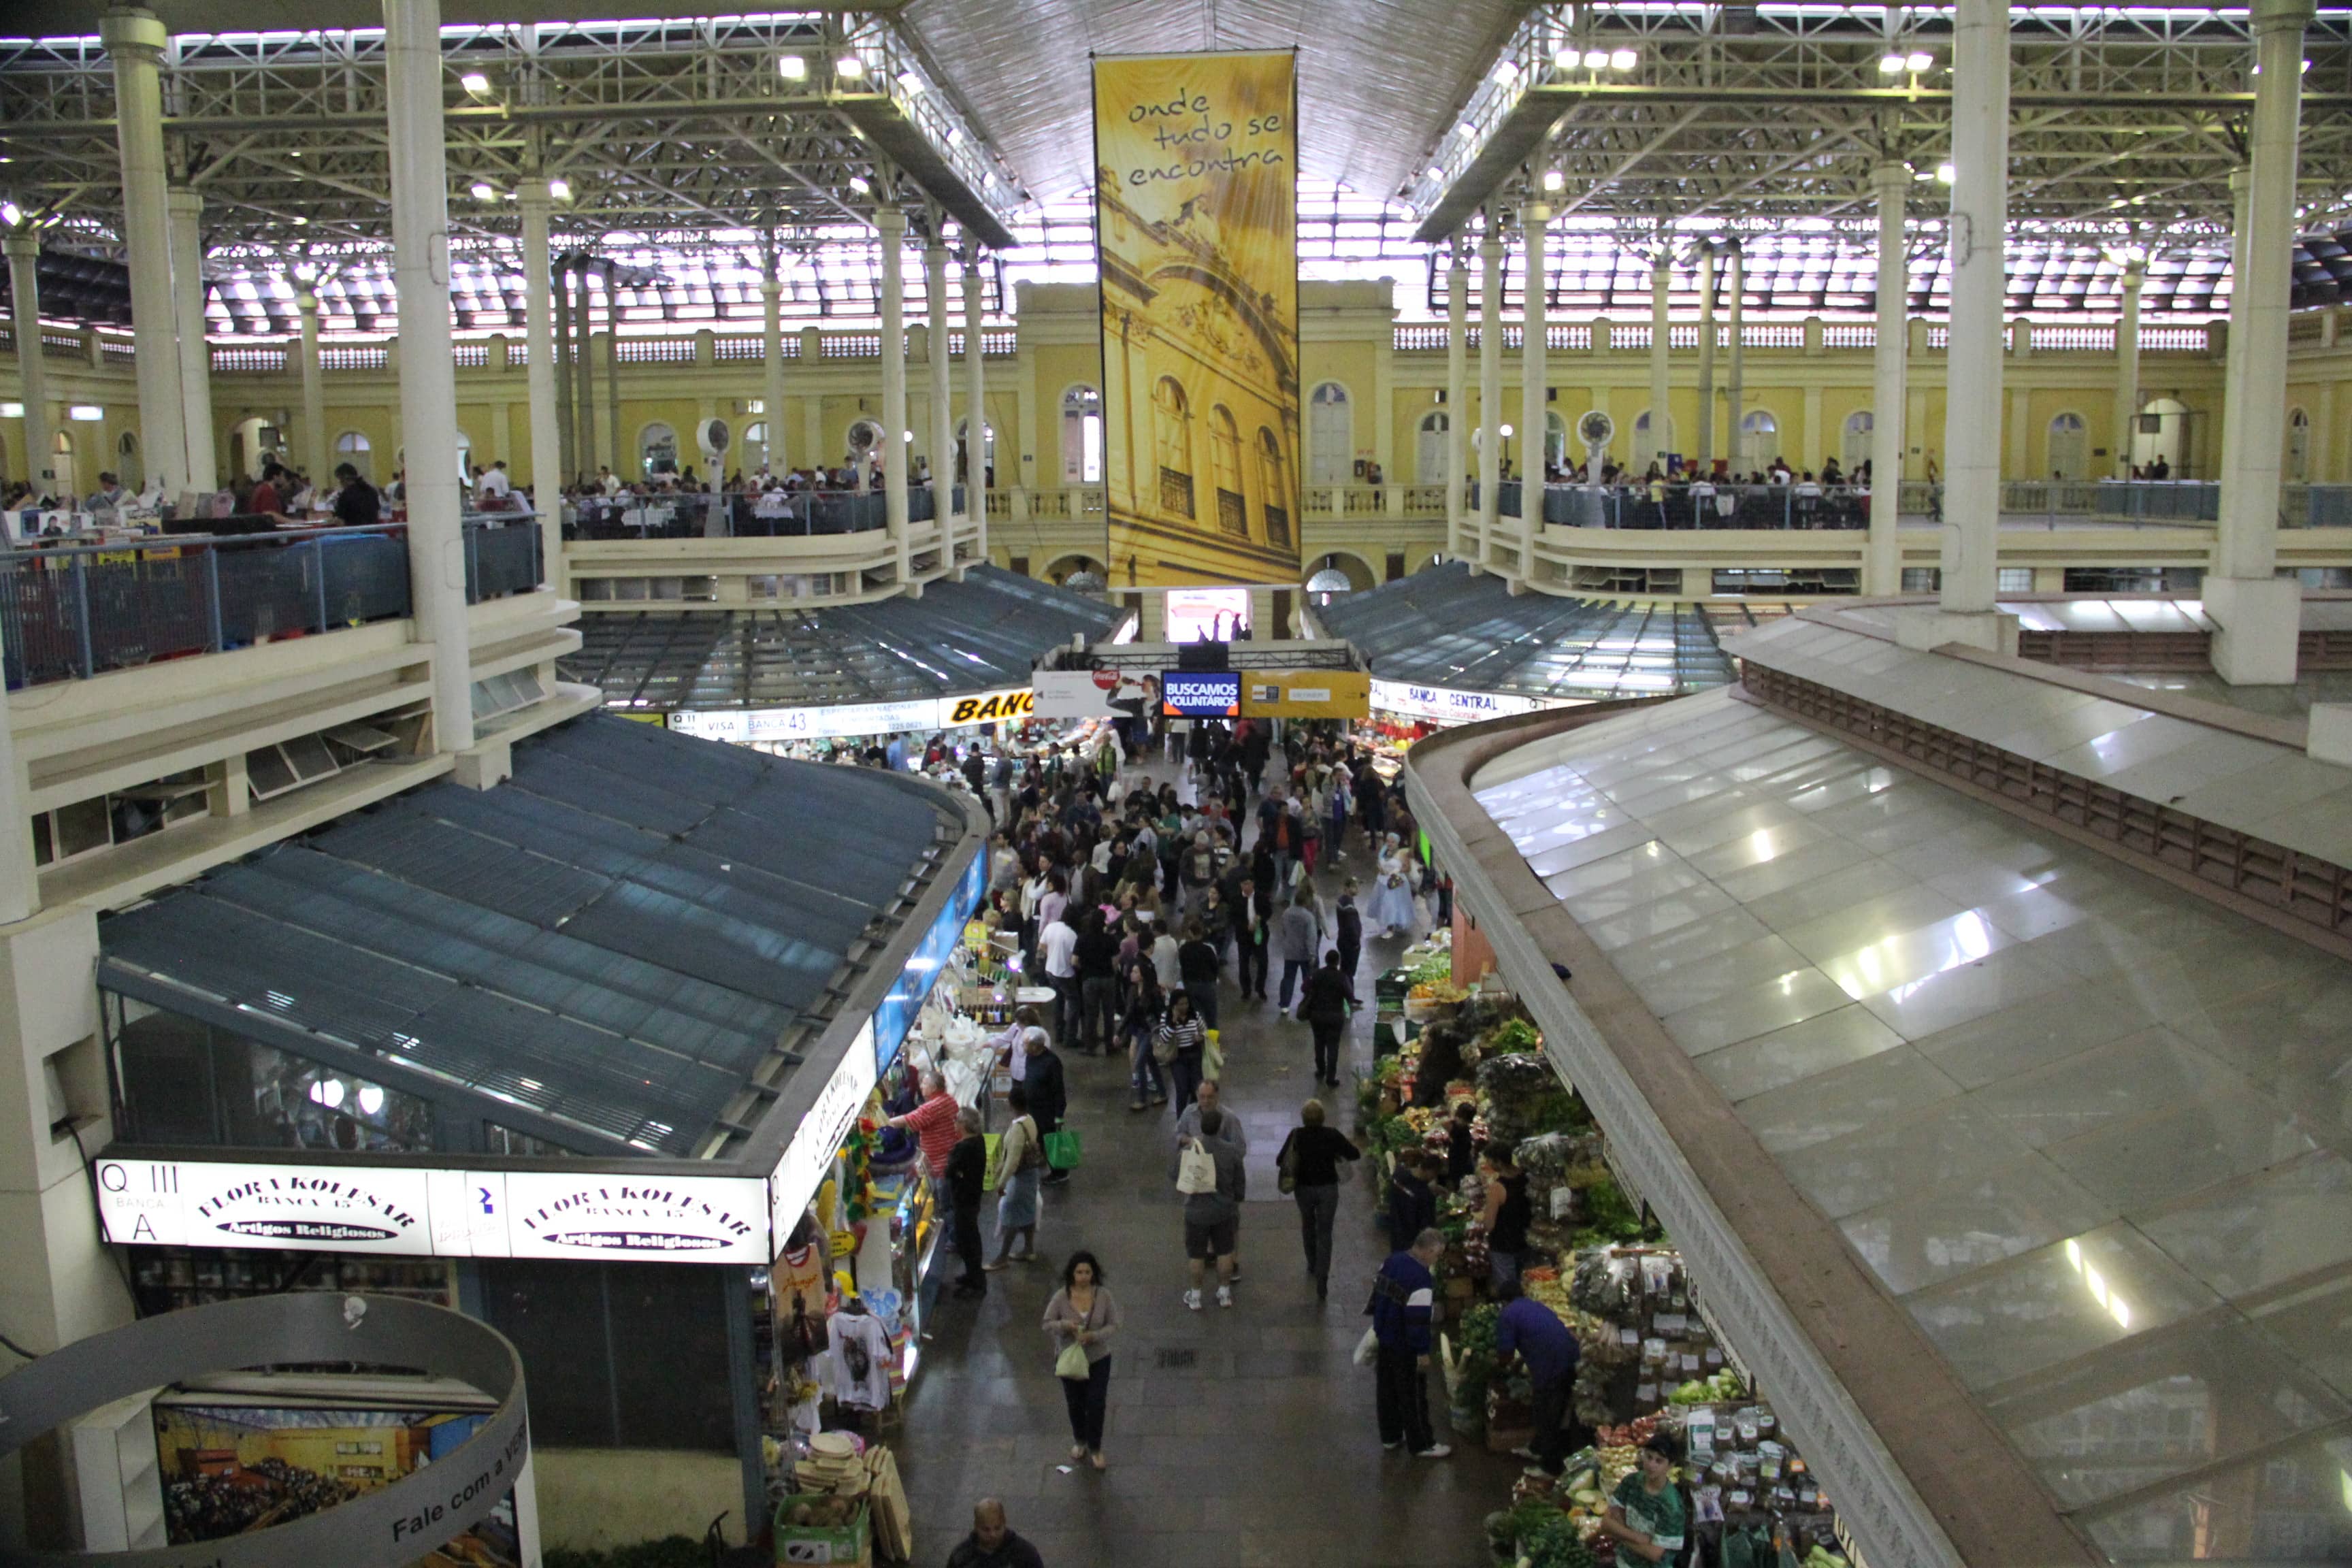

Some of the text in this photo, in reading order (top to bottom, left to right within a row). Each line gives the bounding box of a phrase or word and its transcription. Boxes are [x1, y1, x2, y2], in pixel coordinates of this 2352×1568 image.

[1129, 87, 1209, 122] onde
[1154, 114, 1281, 150] tudo se
[1129, 148, 1283, 185] encontra
[1166, 683, 1238, 696] BUSCAMOS
[1409, 687, 1437, 703] BANCA
[1450, 693, 1498, 710] CENTRAL
[1166, 695, 1237, 708] VOLUNTÁRIOS
[708, 721, 734, 730] VISA
[748, 713, 806, 731] BANCA 43
[101, 1163, 129, 1192] Q
[116, 1197, 165, 1209] BANCA
[199, 1177, 416, 1227] FLORA KOLESAR
[133, 1213, 157, 1241] A
[227, 1222, 387, 1239] Artigos Religiosos
[555, 1232, 721, 1250] Artigos Religiosos
[392, 1504, 444, 1543] Fale
[451, 1471, 491, 1510] com
[495, 1458, 503, 1476] a
